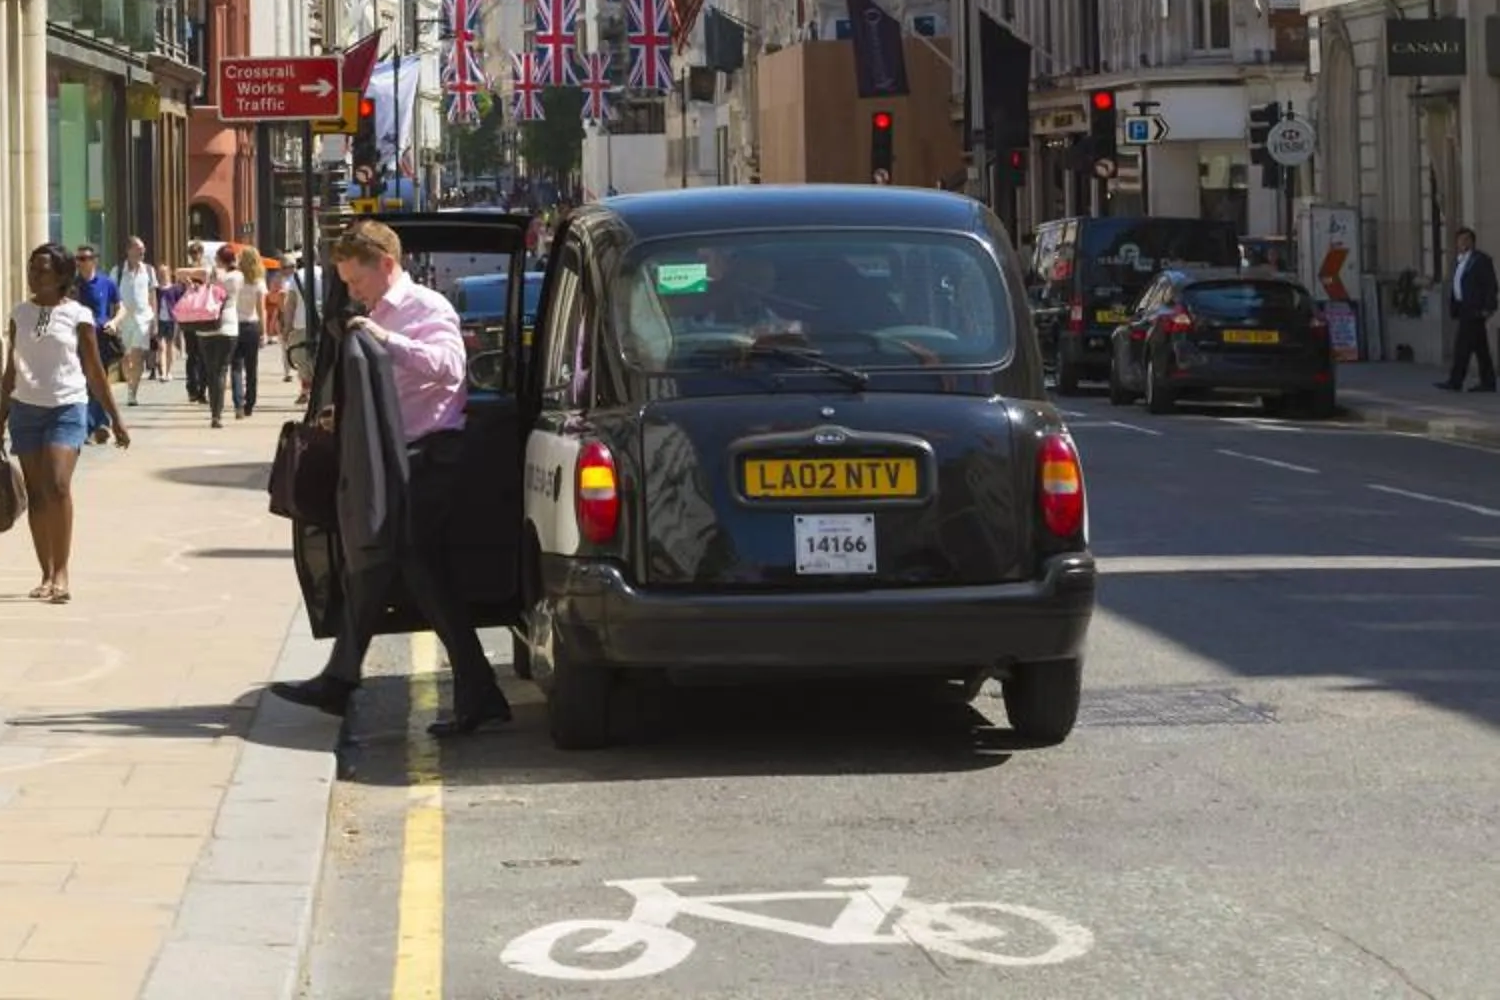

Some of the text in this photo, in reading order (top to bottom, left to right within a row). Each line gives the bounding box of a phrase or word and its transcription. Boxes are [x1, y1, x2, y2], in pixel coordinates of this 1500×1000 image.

[1391, 40, 1461, 53] CANALI
[225, 65, 296, 79] Crossrail
[236, 81, 285, 95] Works
[236, 97, 286, 112] Traffic
[759, 462, 901, 490] LA02 NTV
[806, 535, 867, 553] 14166
